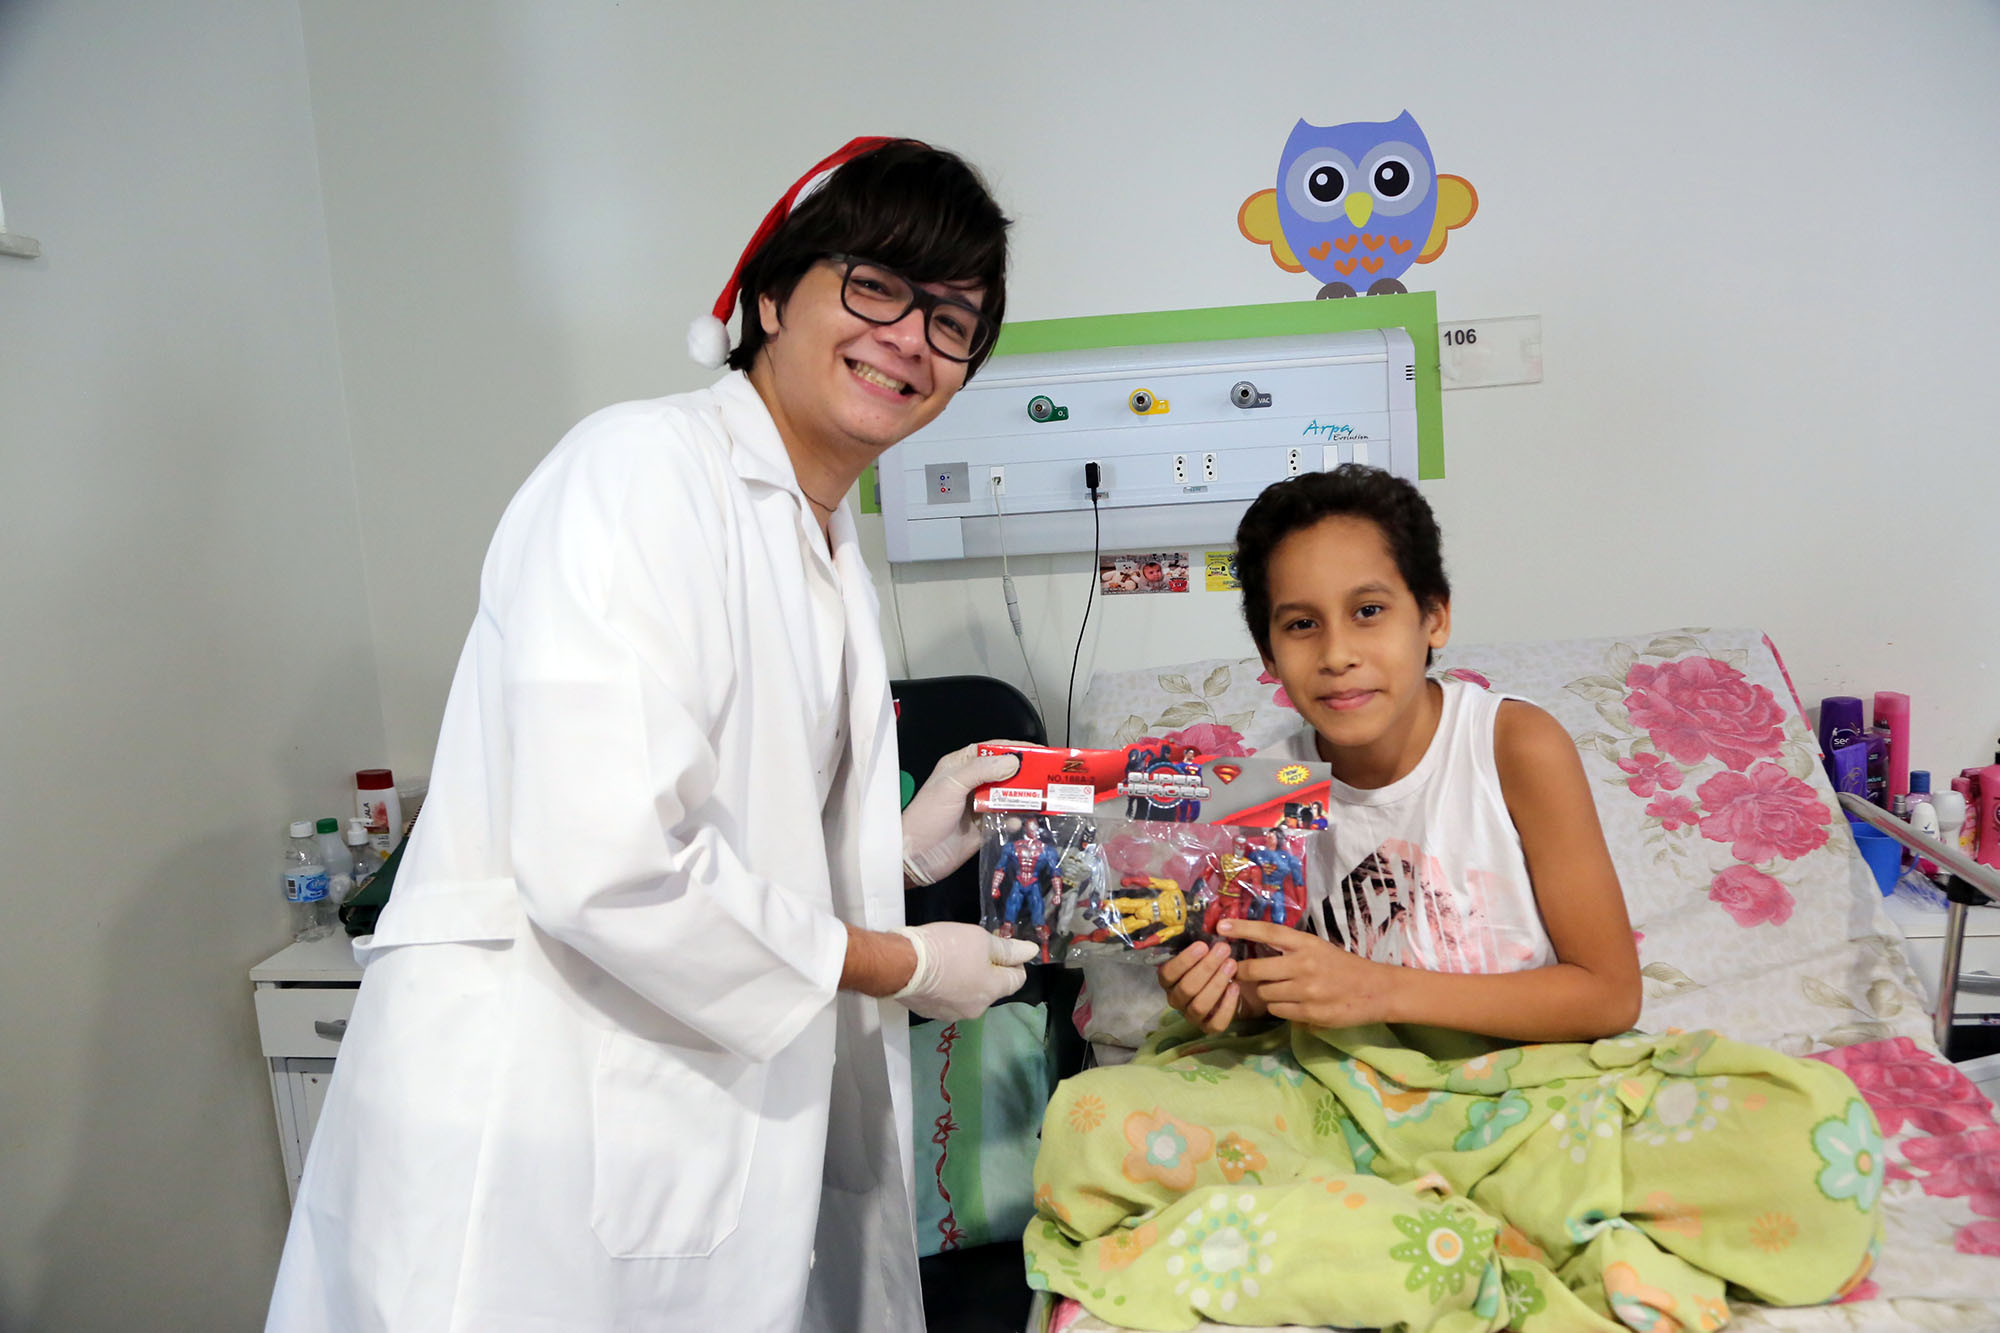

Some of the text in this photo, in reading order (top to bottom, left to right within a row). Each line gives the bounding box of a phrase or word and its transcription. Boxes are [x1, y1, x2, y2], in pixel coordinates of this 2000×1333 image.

[1443, 328, 1478, 347] 106
[1257, 397, 1271, 405] VAC
[1302, 419, 1355, 441] Arpa
[980, 749, 995, 757] 3+
[1127, 771, 1202, 787] SUPER
[1001, 790, 1041, 799] WARNING:
[1117, 782, 1212, 800] HEROES
